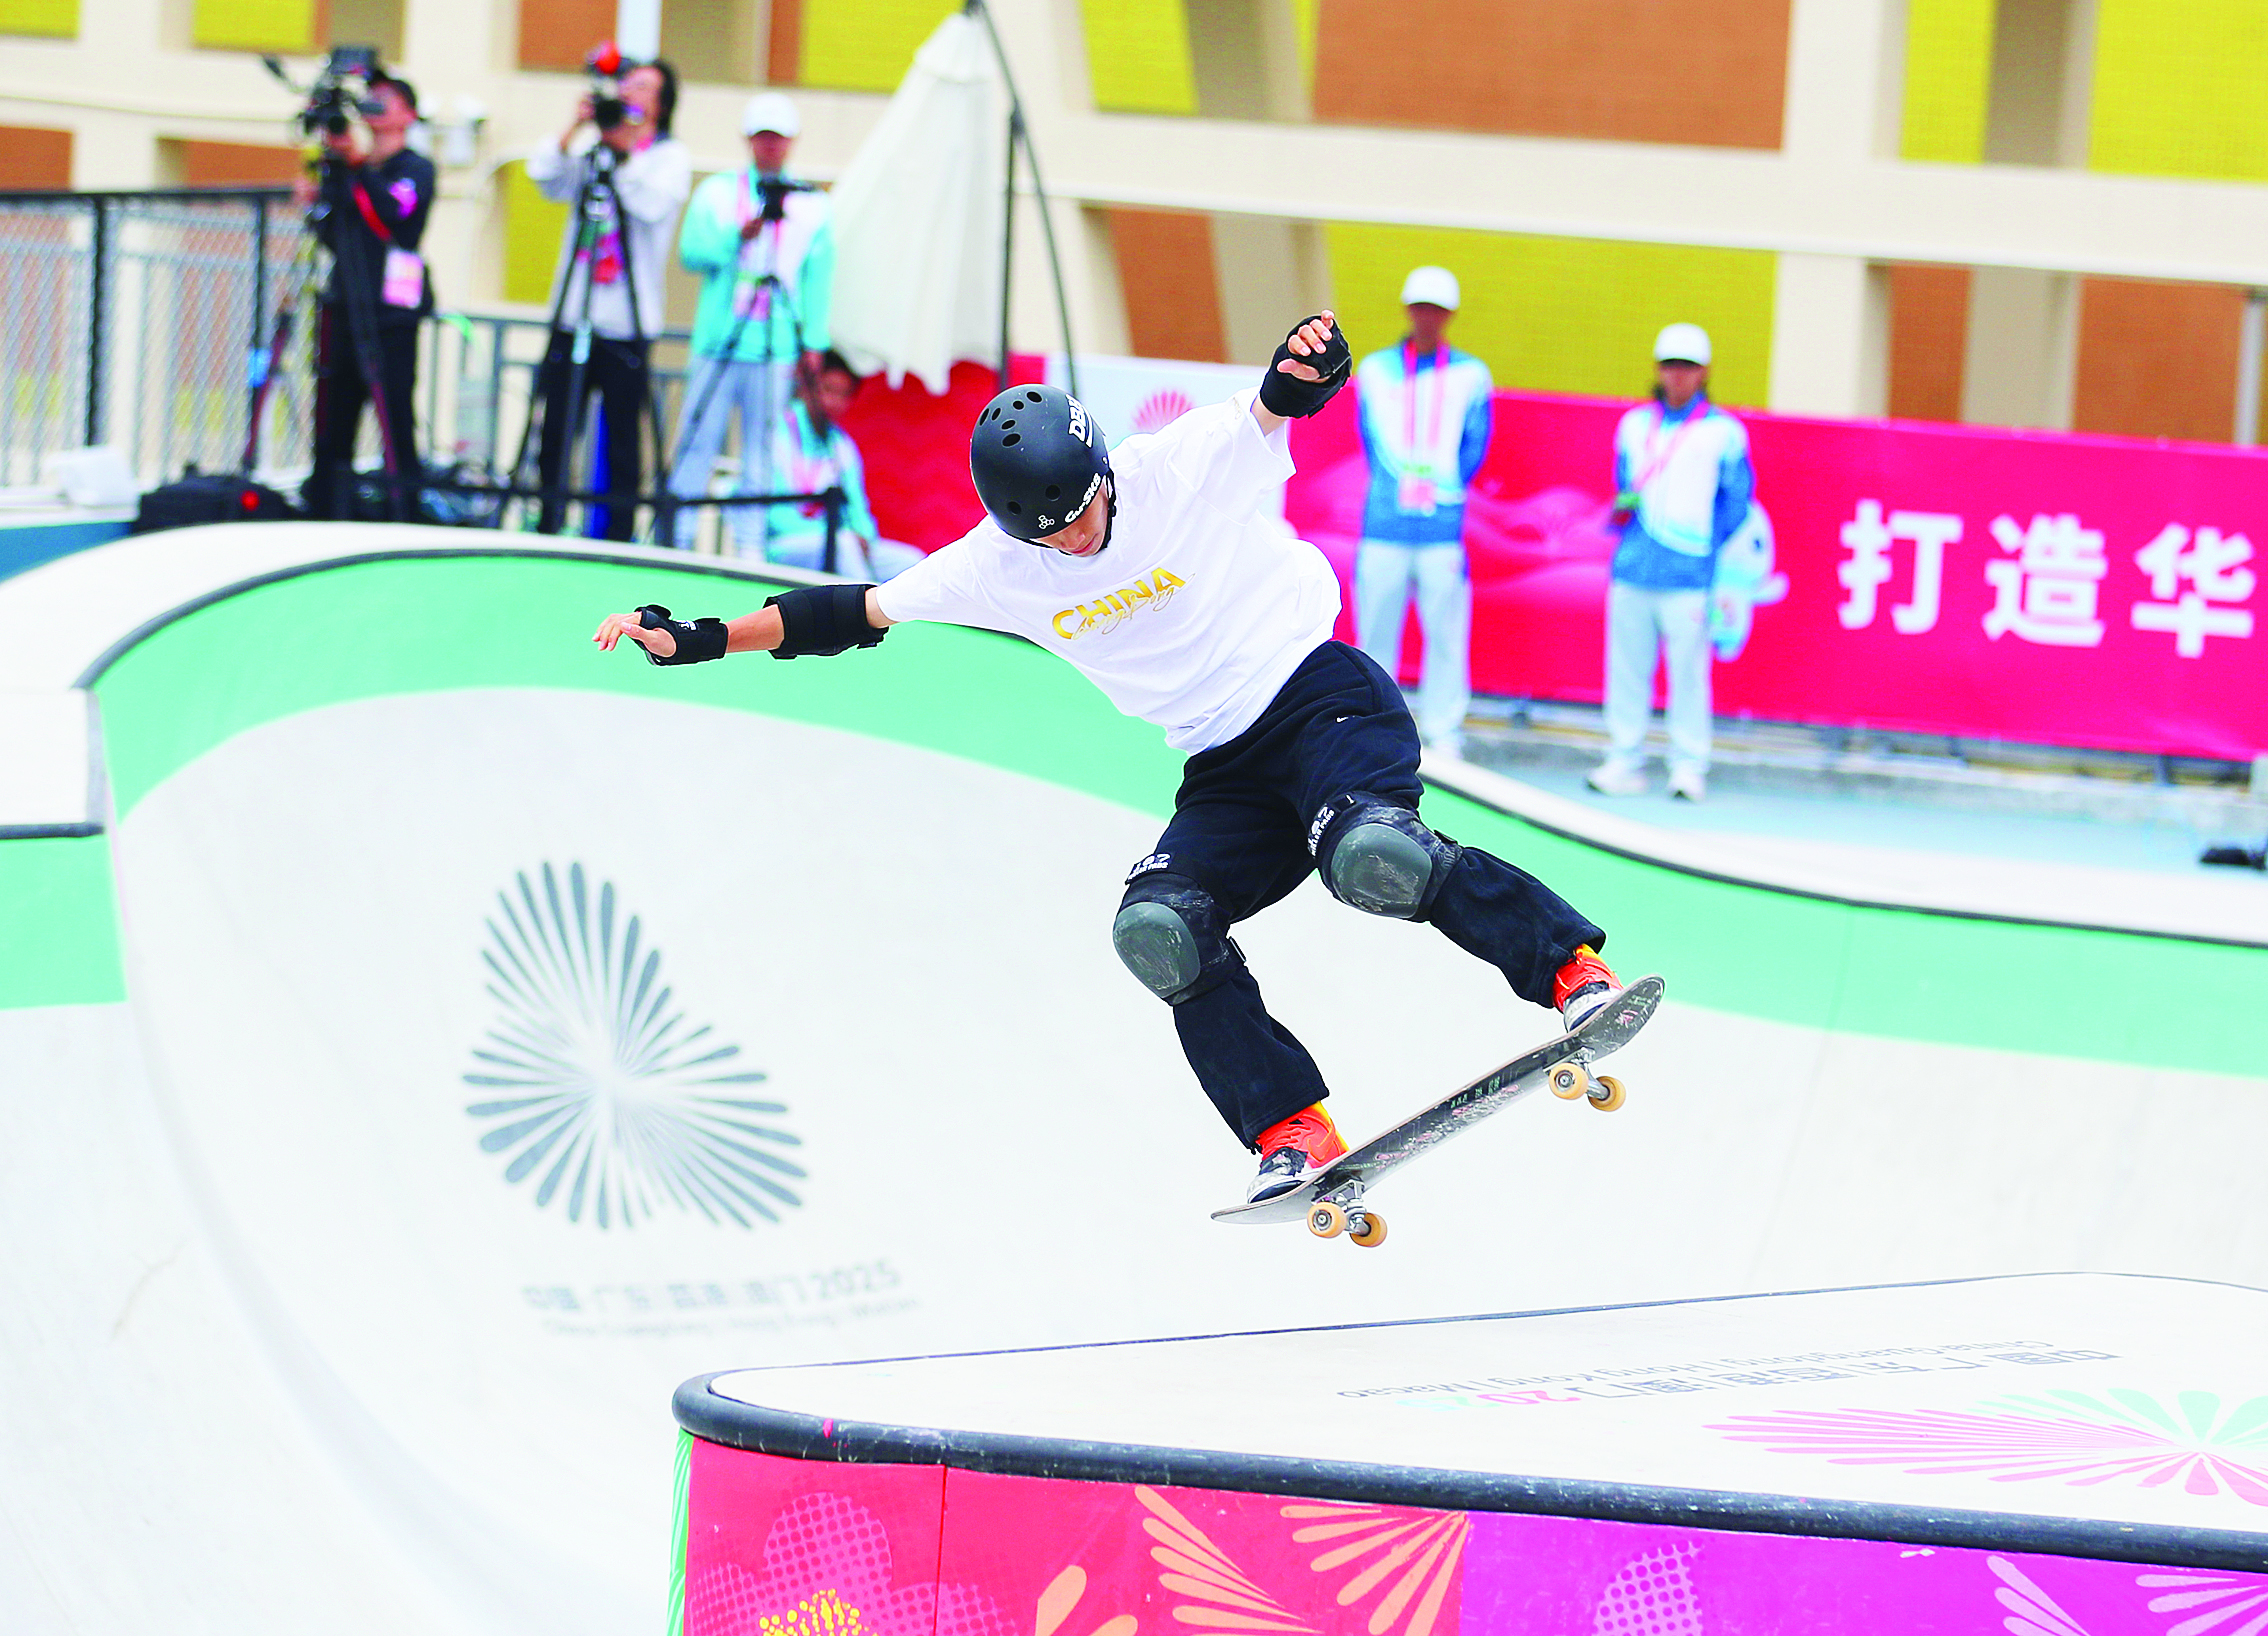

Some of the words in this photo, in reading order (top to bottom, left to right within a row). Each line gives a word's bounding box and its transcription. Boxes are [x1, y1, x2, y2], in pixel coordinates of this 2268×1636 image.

[1052, 567, 1187, 639] CHINA
[1837, 497, 2258, 659] 打造华
[1337, 1382, 1482, 1399] Macao
